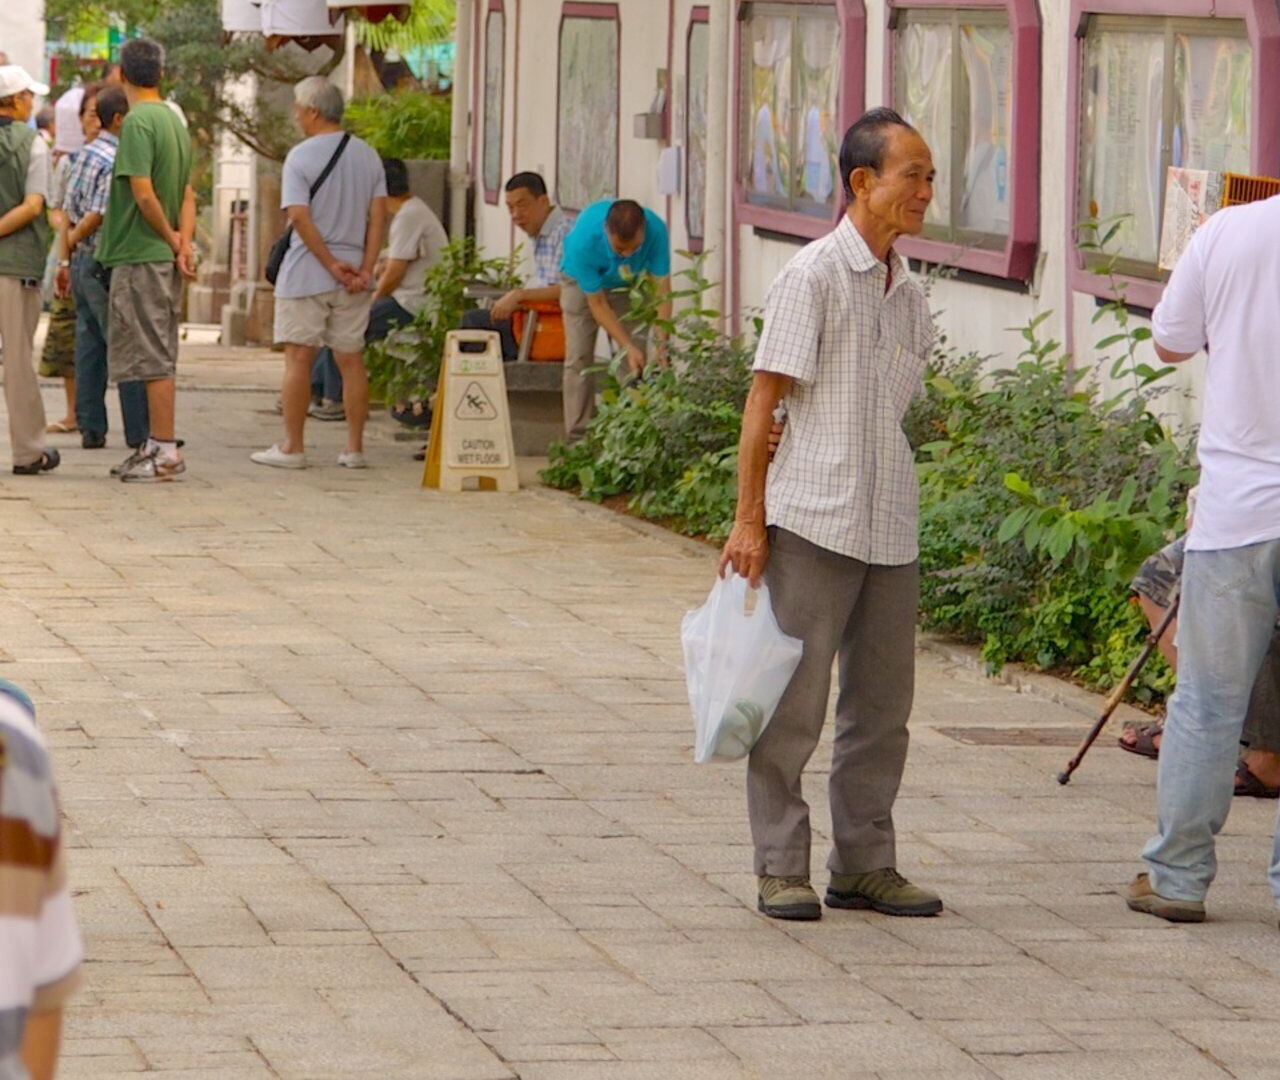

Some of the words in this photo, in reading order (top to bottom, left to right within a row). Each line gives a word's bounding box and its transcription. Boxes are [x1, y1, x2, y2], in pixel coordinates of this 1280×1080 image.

[462, 439, 495, 450] CAUTION
[458, 453, 474, 465] WET
[475, 453, 501, 465] FLOOR
